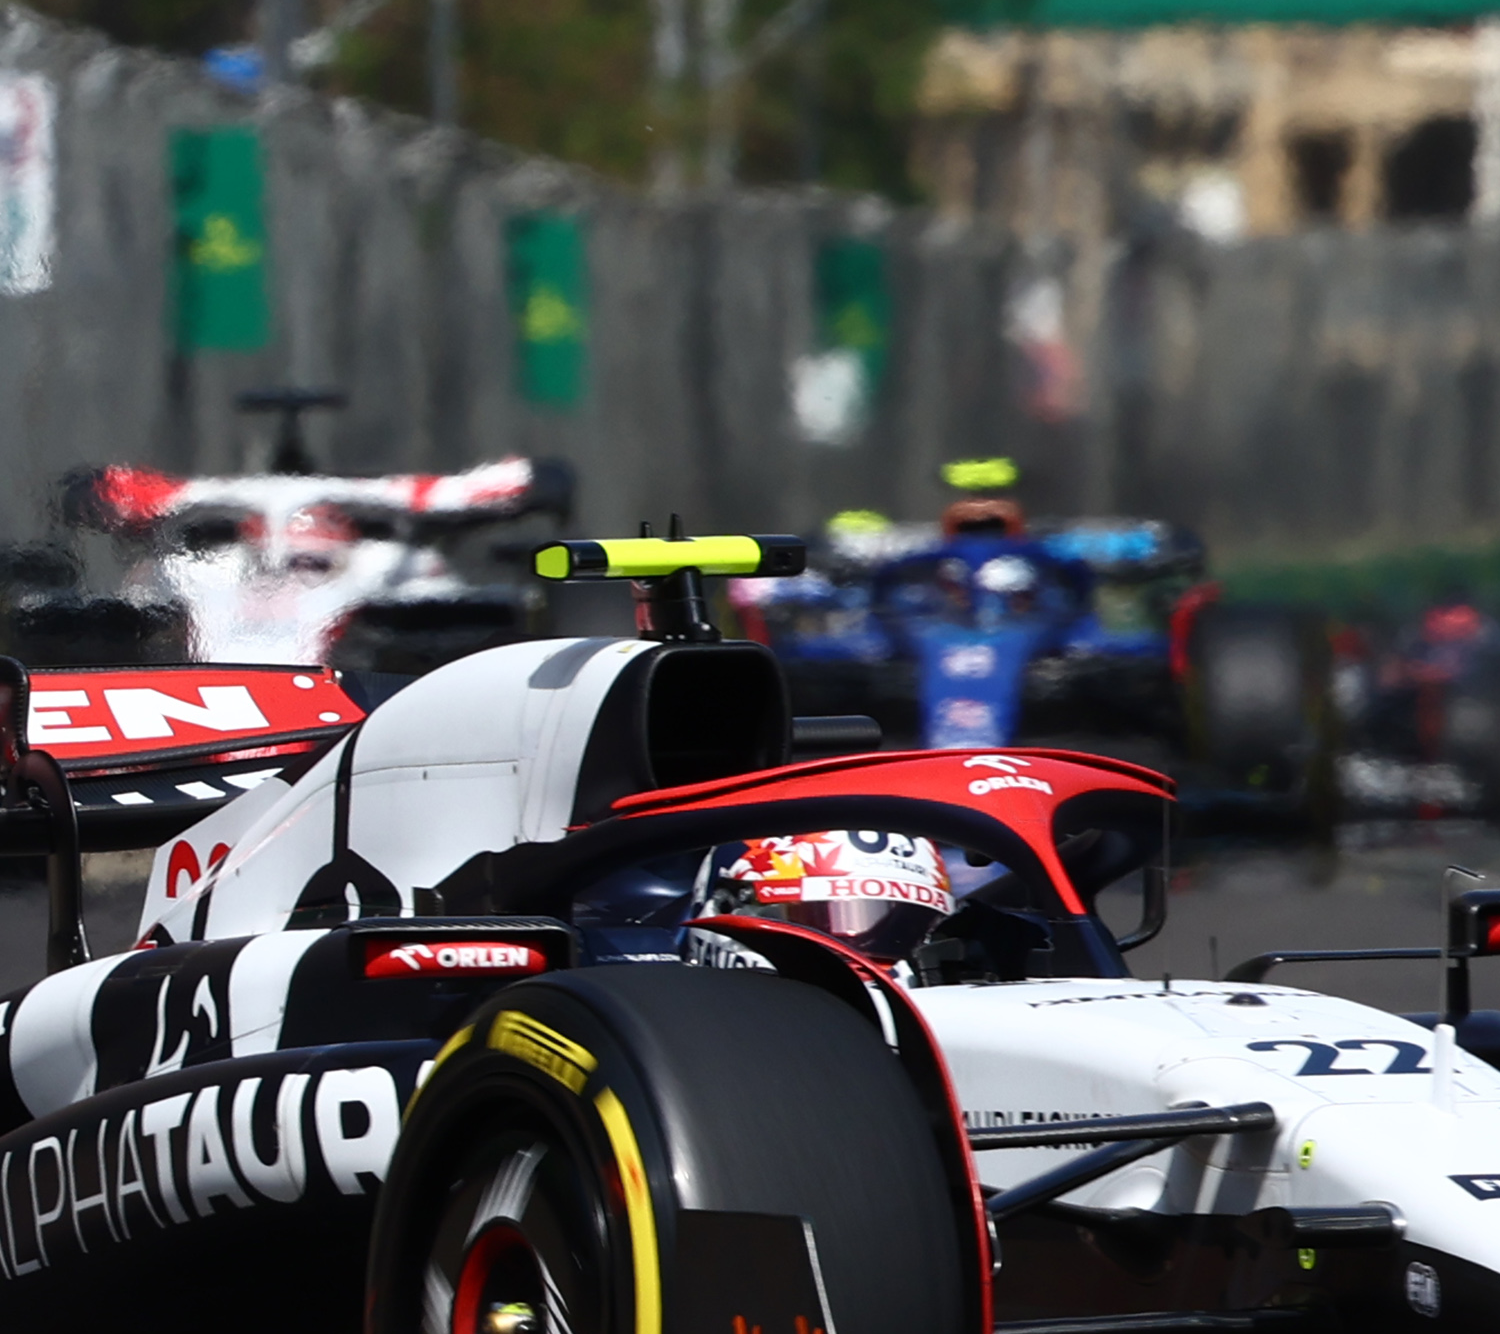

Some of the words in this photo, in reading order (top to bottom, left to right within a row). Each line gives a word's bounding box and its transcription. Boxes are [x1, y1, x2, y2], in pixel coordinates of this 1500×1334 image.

[967, 774, 1054, 795] ORLEN
[827, 878, 949, 912] HONDA
[436, 946, 529, 968] ORLEN
[1246, 1039, 1460, 1076] 22
